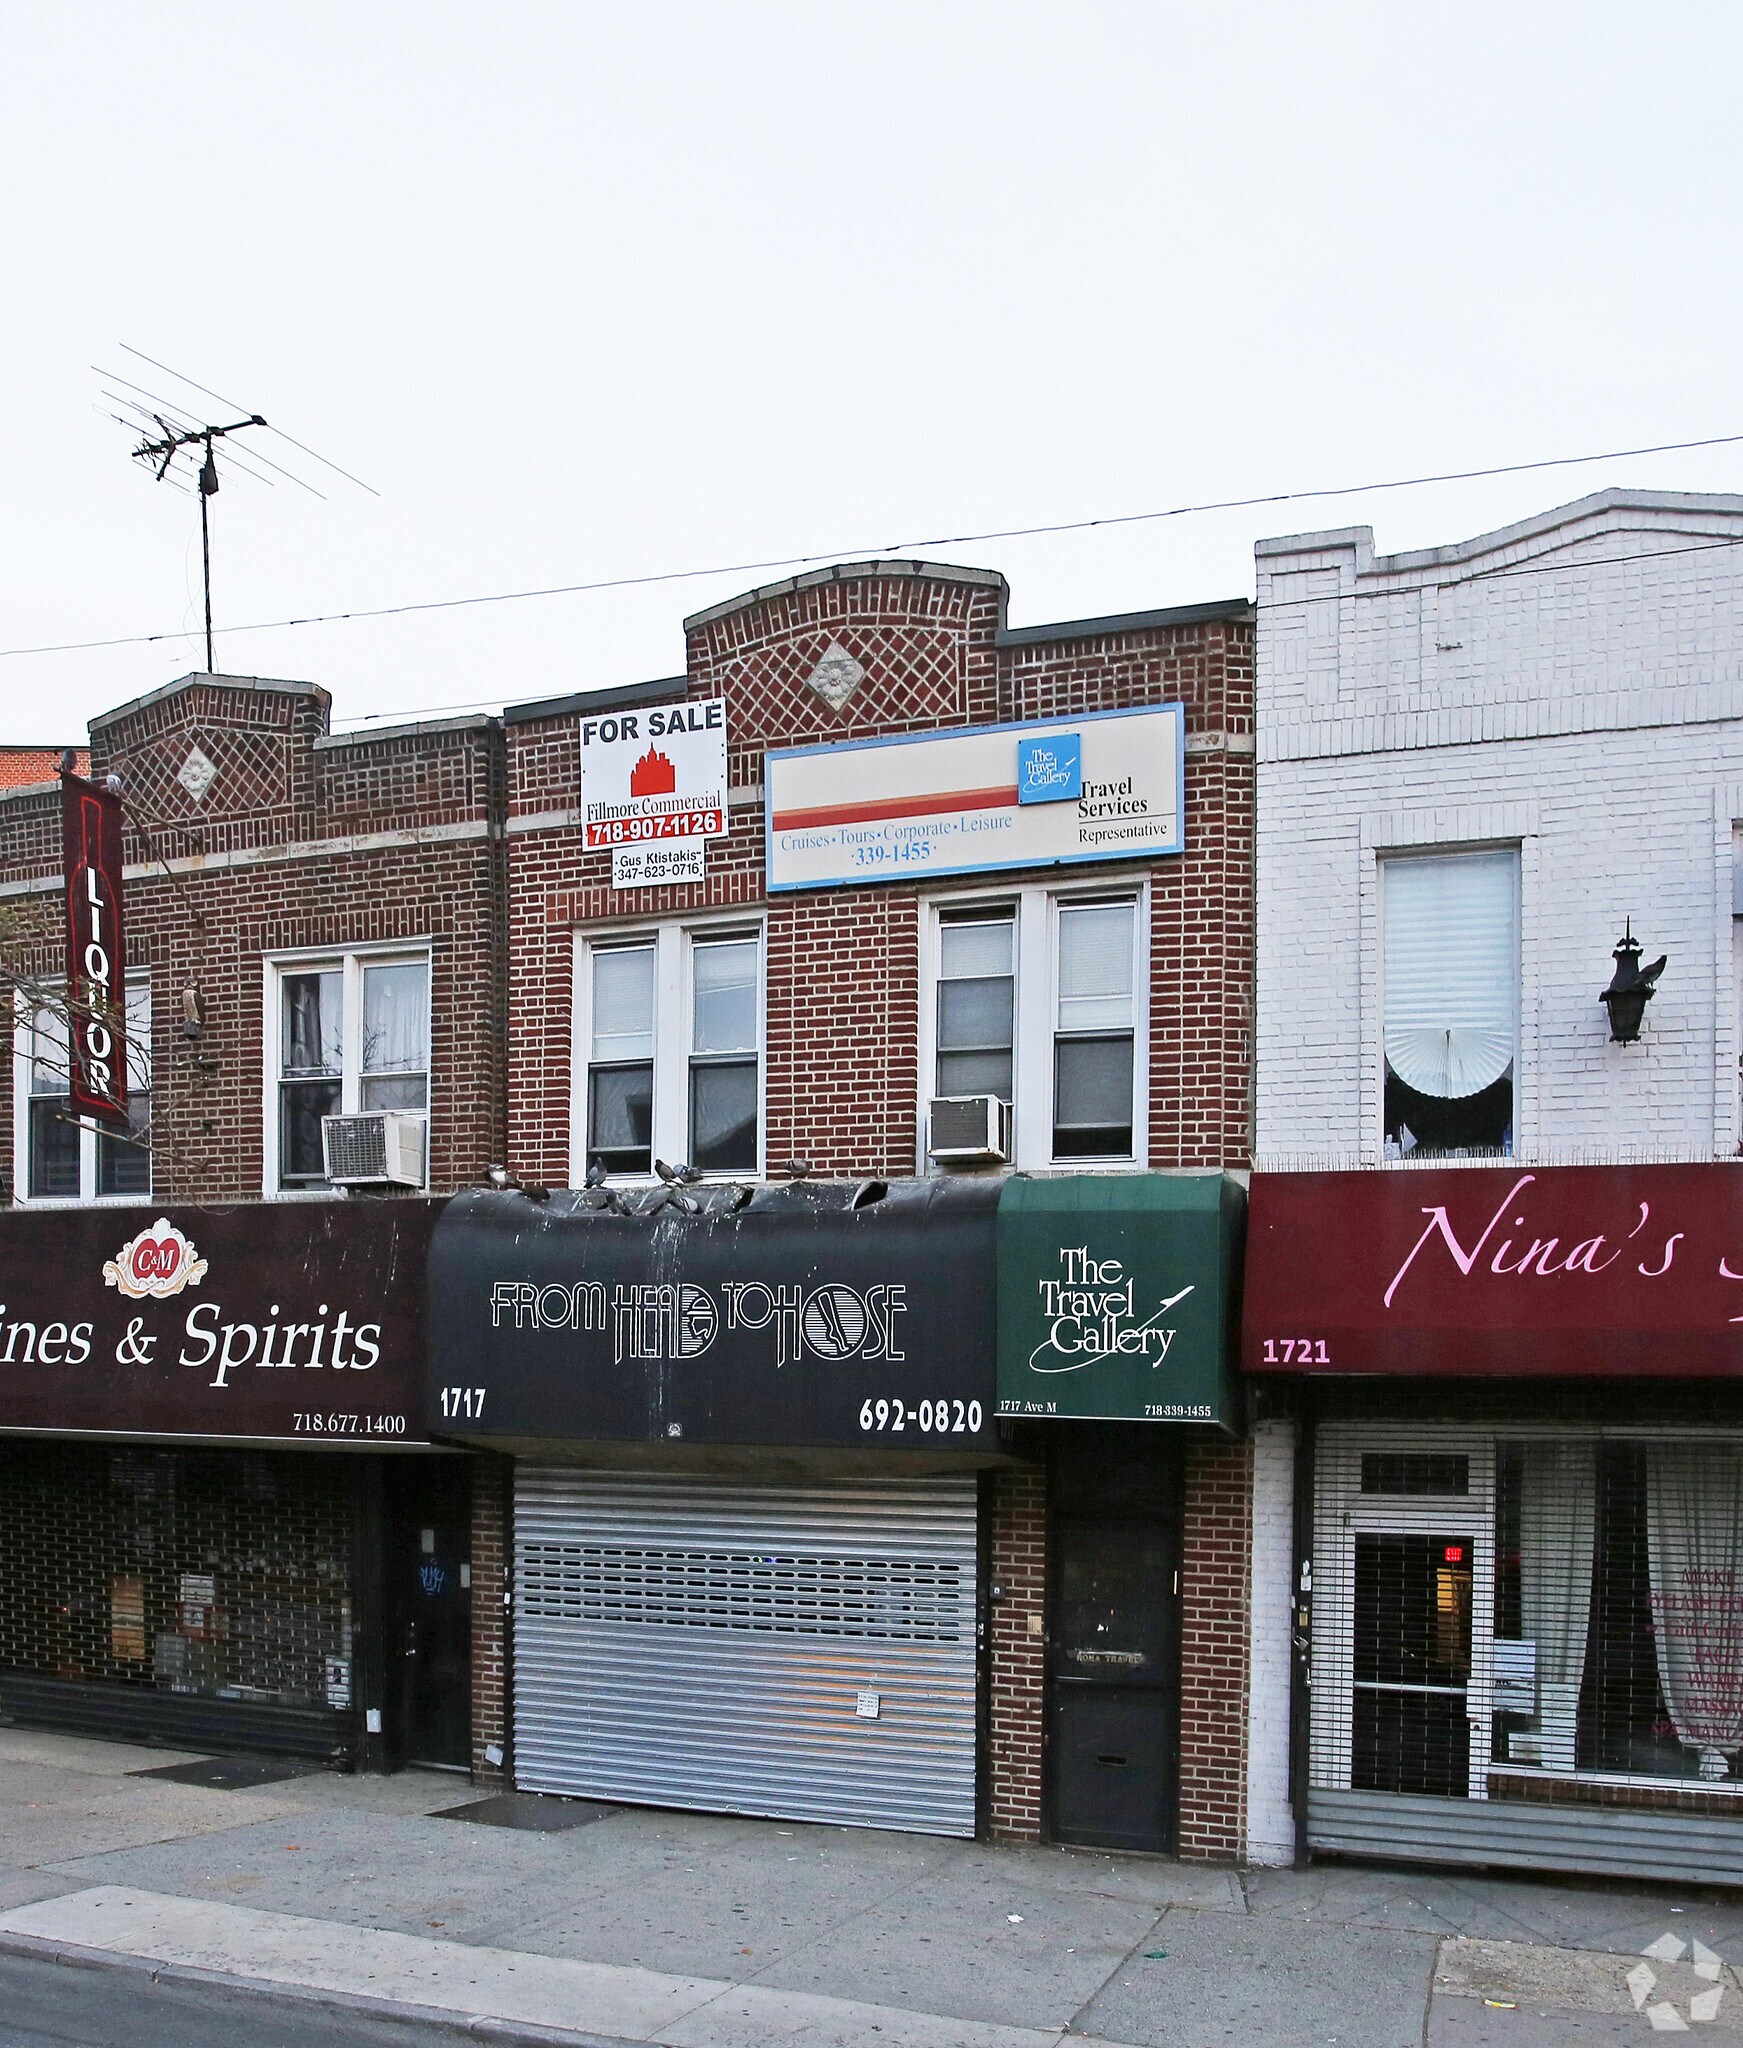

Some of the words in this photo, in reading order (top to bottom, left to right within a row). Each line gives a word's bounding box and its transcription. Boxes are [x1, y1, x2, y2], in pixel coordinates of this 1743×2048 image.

[583, 716, 639, 746] FOR
[648, 704, 722, 737] SALE
[1025, 758, 1058, 775] Travel
[1032, 748, 1053, 763] The
[1029, 769, 1071, 787] Gallery
[1081, 776, 1132, 799] Travel
[587, 801, 640, 822] Fillmore
[641, 790, 721, 815] Commercial
[1078, 797, 1148, 819] Services
[591, 812, 717, 845] 718-907-1126
[781, 832, 830, 851] Cruises
[838, 828, 876, 845] Tours
[883, 820, 951, 843] Corporate
[960, 814, 1013, 833] Leisure
[1079, 822, 1167, 844] Representative
[620, 855, 642, 867] Gus
[646, 849, 698, 865] Ktistakis
[855, 841, 931, 866] 339-1455
[617, 863, 700, 881] 347-623-0716
[85, 866, 113, 1096] LIQUOR
[1383, 1174, 1685, 1308] Nina's
[138, 1249, 175, 1271] C&M
[1059, 1246, 1124, 1285] The
[1038, 1277, 1135, 1318] Travel
[489, 1281, 607, 1330] FROM
[610, 1283, 719, 1364] HEAD
[721, 1281, 775, 1329] TO
[773, 1283, 908, 1368] HOSE
[115, 1316, 157, 1365] &
[179, 1303, 381, 1387] Spirits
[1050, 1314, 1176, 1369] Gallery
[1262, 1339, 1331, 1364] 1721
[440, 1387, 487, 1418] 1717
[859, 1399, 983, 1433] 692-0820
[1000, 1400, 1021, 1411] 1717
[1024, 1401, 1043, 1412] Ave
[1046, 1402, 1057, 1413] M
[293, 1413, 406, 1434] 718.677.1400
